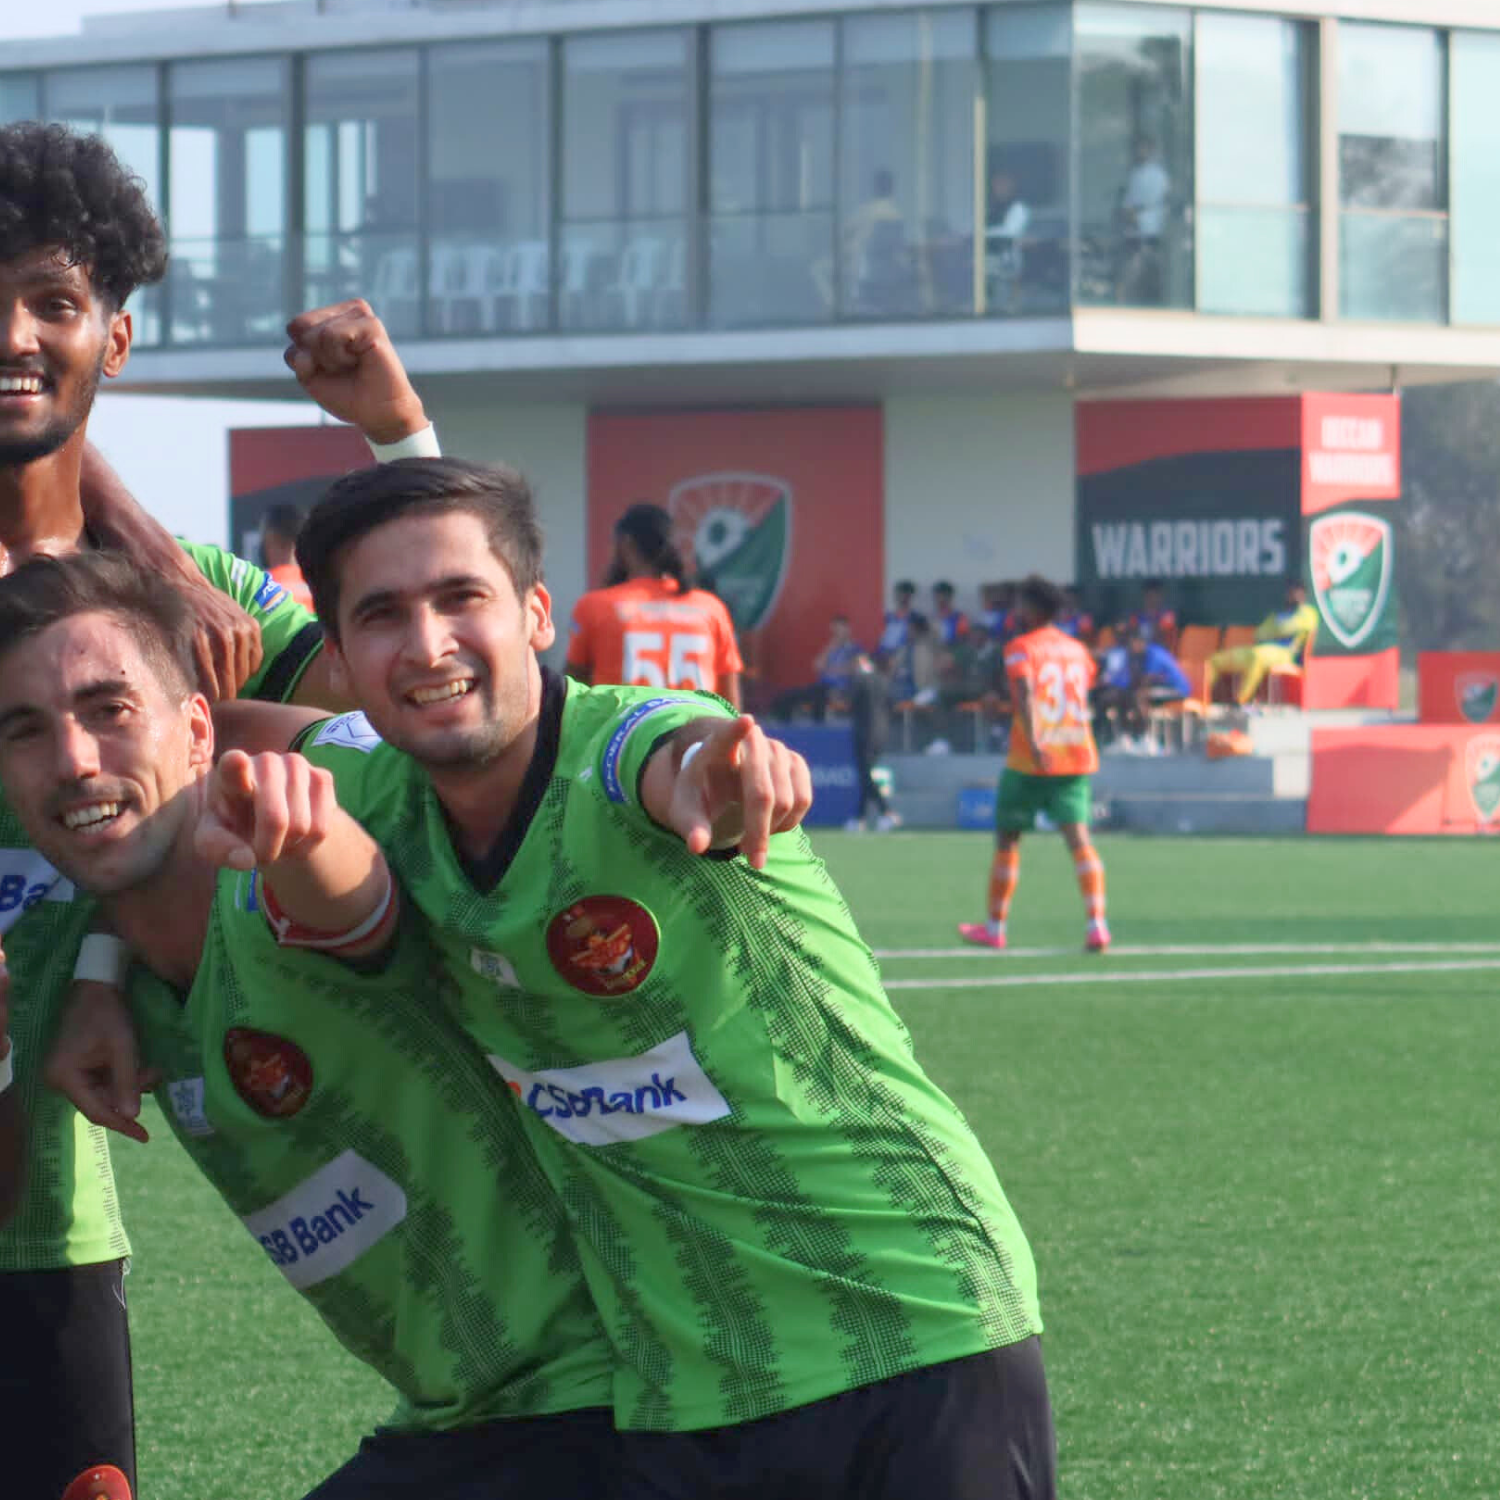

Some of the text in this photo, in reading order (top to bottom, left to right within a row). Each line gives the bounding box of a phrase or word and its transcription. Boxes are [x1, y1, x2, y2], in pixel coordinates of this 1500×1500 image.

[1092, 519, 1285, 577] WARRIORS
[1038, 663, 1094, 722] 33
[289, 1187, 375, 1257] Bank
